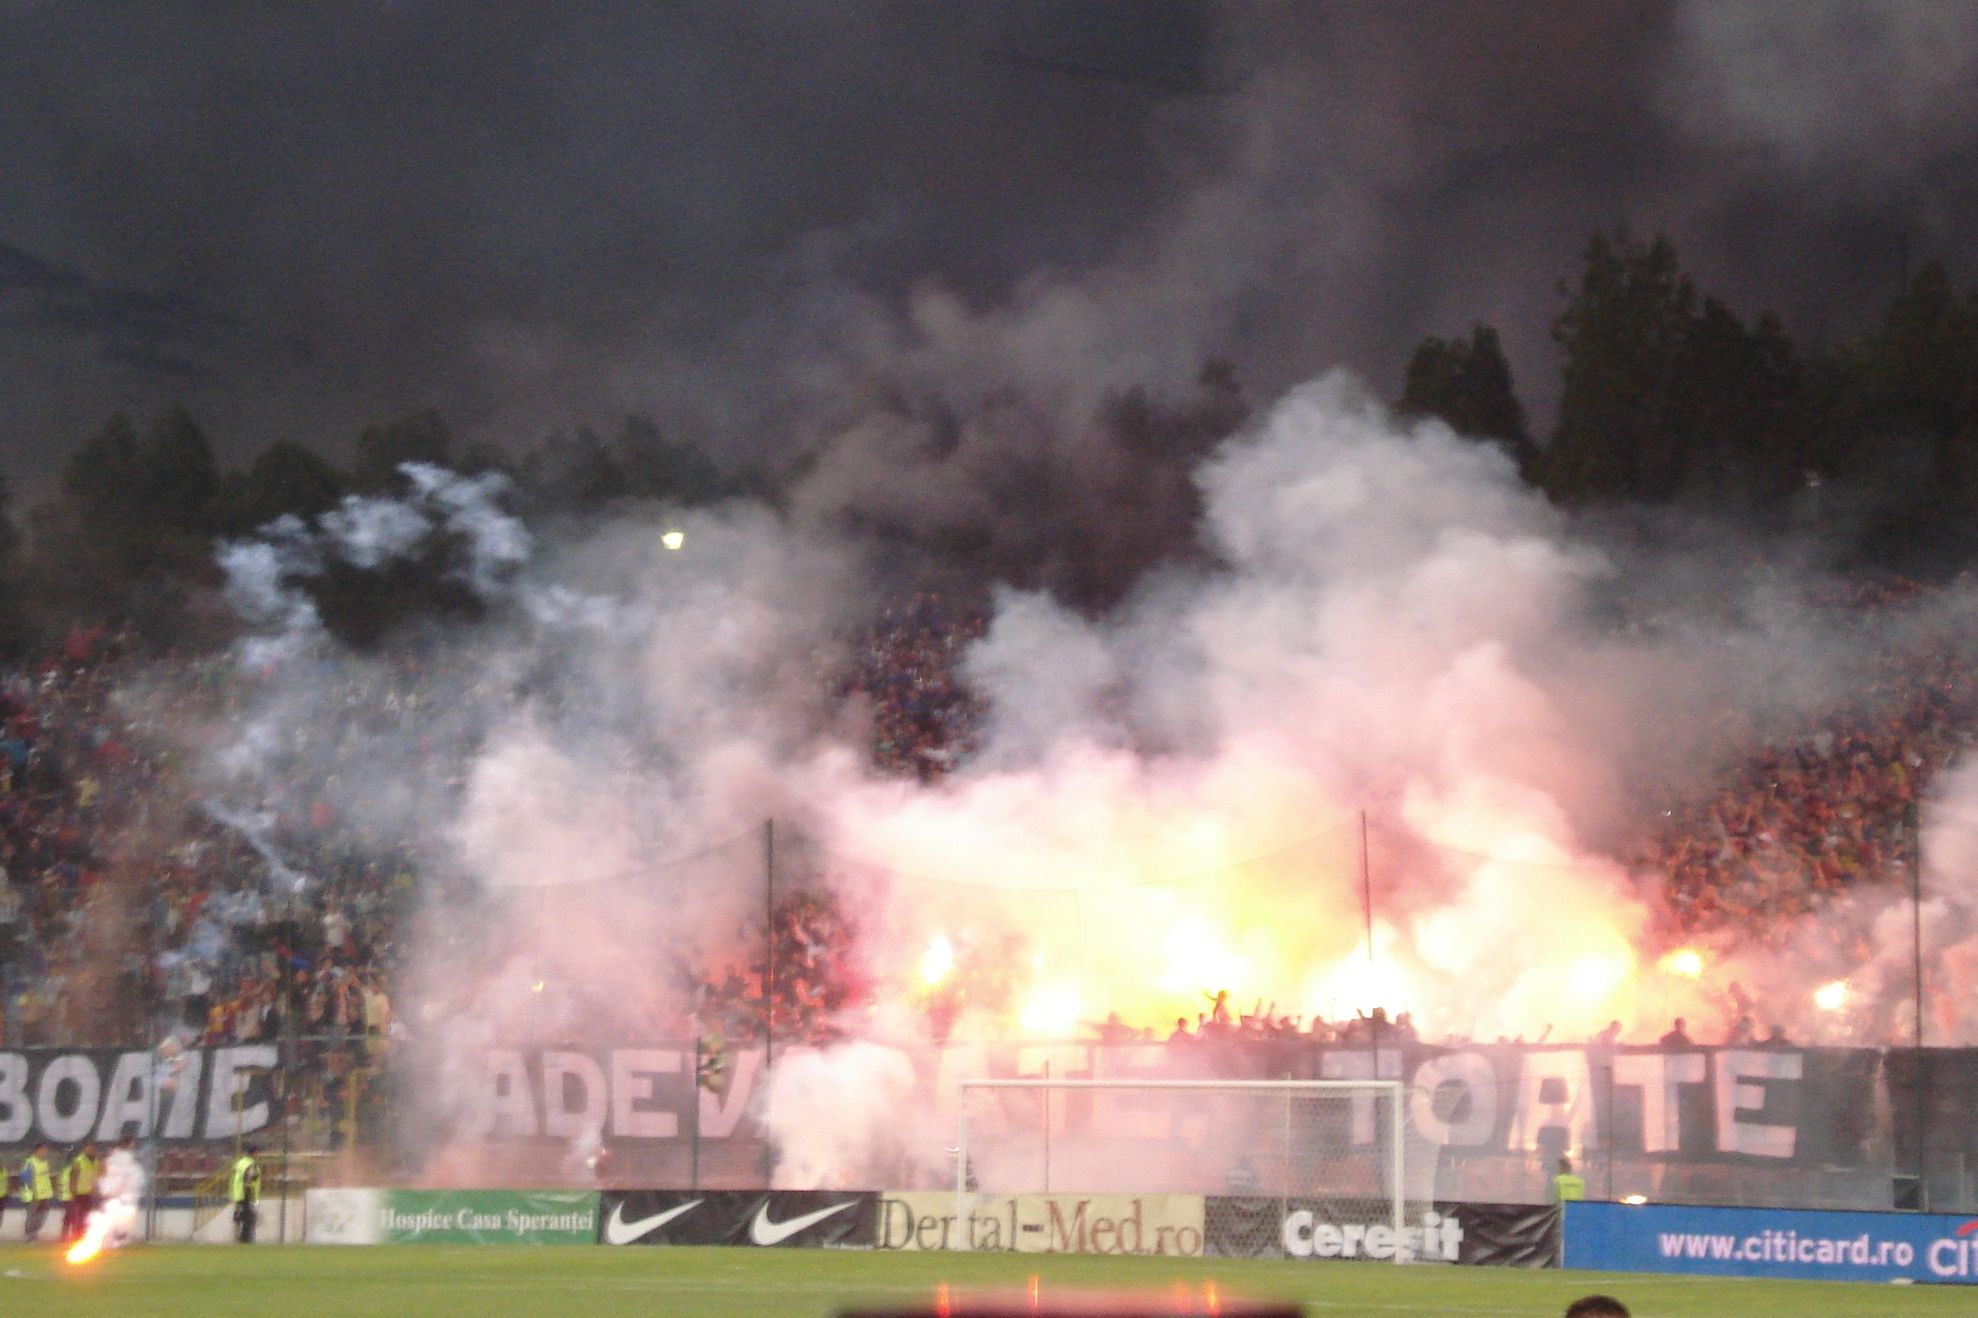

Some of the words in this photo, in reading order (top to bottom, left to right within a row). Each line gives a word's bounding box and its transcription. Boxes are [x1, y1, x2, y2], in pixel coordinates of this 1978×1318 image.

[1321, 1049, 1803, 1158] TOATE
[380, 1207, 452, 1234] Hospice
[456, 1207, 502, 1230] Casa
[1660, 1230, 1914, 1267] www.citicard.ro
